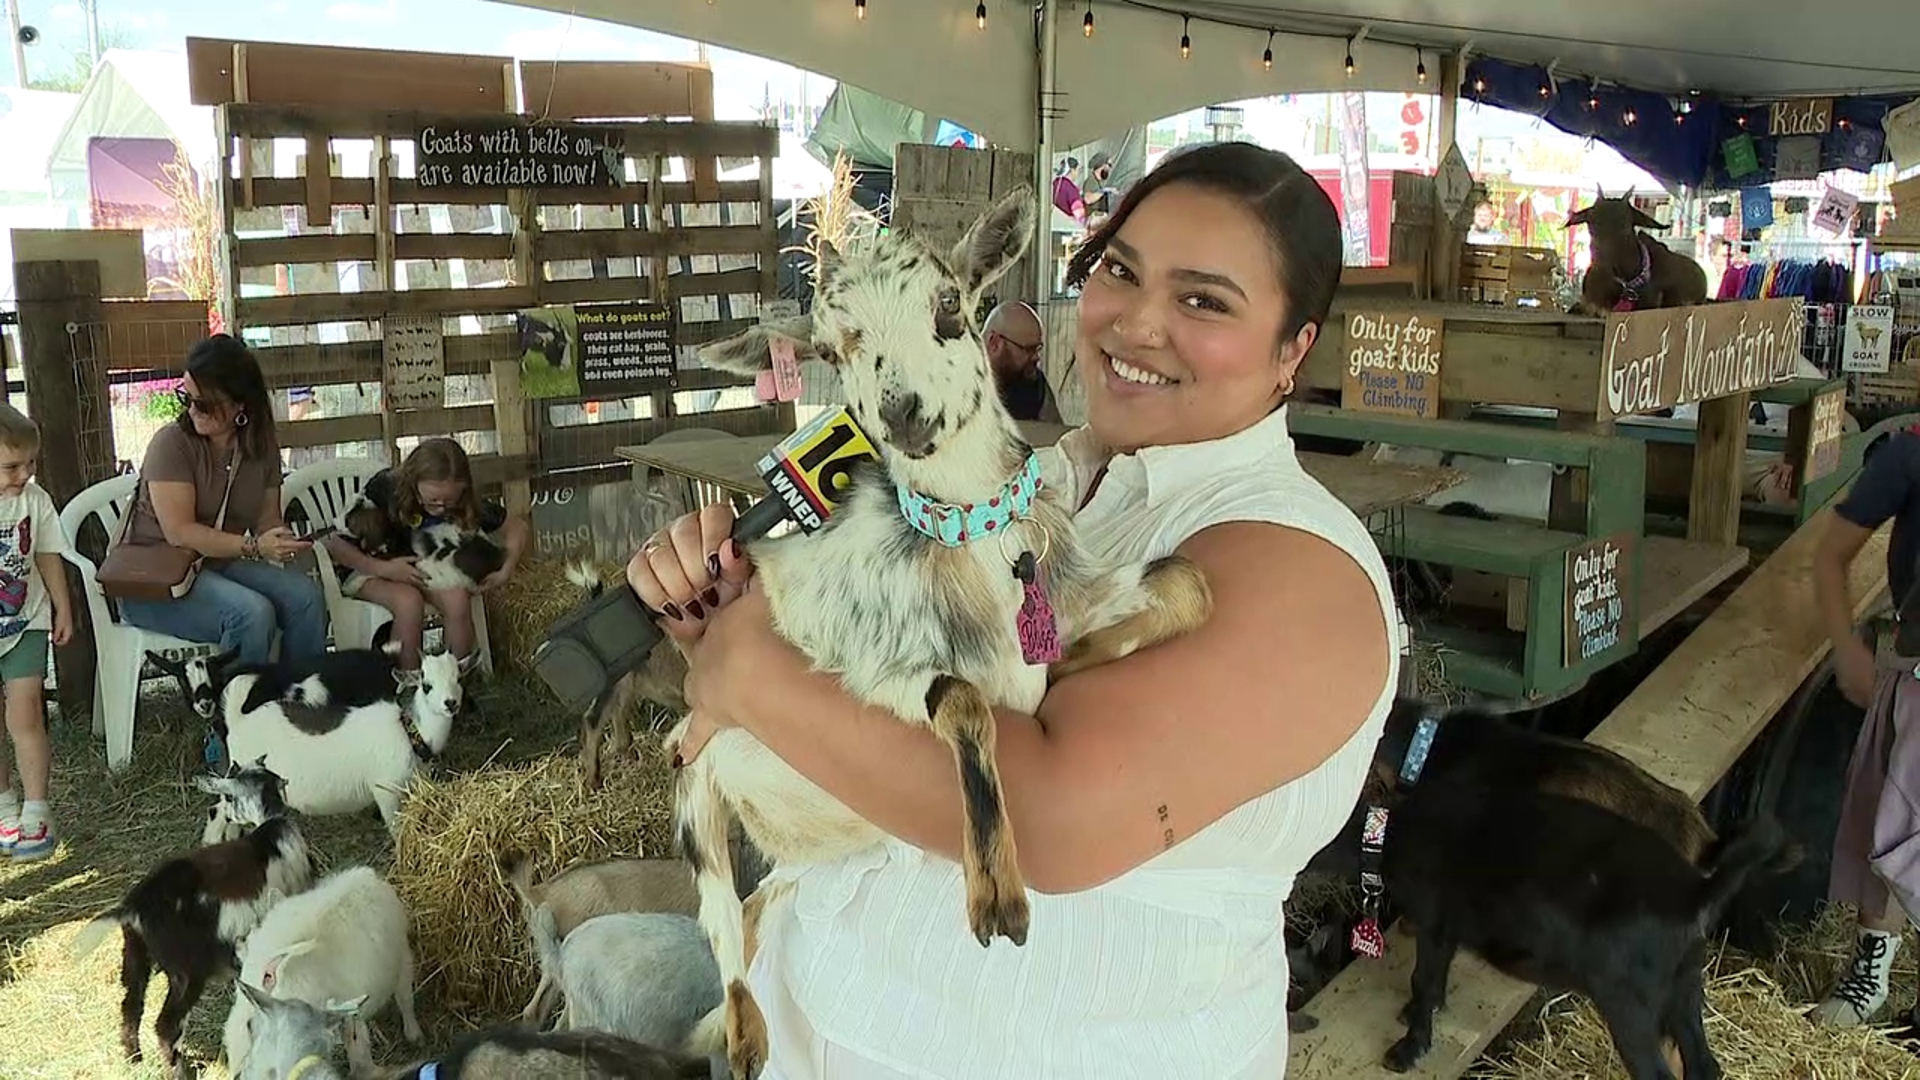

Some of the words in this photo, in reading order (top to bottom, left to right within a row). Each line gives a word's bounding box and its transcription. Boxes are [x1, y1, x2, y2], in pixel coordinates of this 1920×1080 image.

[1770, 100, 1828, 136] Kids
[421, 126, 473, 155] Goats
[479, 127, 521, 155] with
[527, 126, 569, 155] bells
[575, 137, 596, 157] on
[419, 163, 453, 187] are
[461, 157, 548, 186] available
[552, 159, 597, 186] now!
[576, 312, 604, 323] What
[605, 311, 619, 322] do
[620, 311, 648, 325] goats
[650, 310, 671, 321] eat?
[1853, 308, 1889, 318] SLOW
[609, 331, 623, 340] are
[1350, 314, 1400, 350] Only
[1402, 316, 1436, 345] for
[587, 344, 608, 355] They
[608, 343, 623, 353] eat
[1349, 345, 1397, 376] goat
[1607, 314, 1671, 415] Goat
[1676, 310, 1776, 405] Mountain
[1852, 351, 1880, 360] GOAT
[584, 370, 601, 380] and
[602, 369, 623, 379] even
[624, 367, 655, 379] poison
[1360, 371, 1398, 389] Please
[1405, 374, 1425, 391] NO
[798, 423, 875, 504] 16
[770, 469, 822, 529] WNEP
[1574, 548, 1601, 585] Only
[1602, 542, 1619, 574] for
[1574, 582, 1596, 621] goat
[1579, 607, 1606, 637] Please
[1608, 597, 1622, 623] NO
